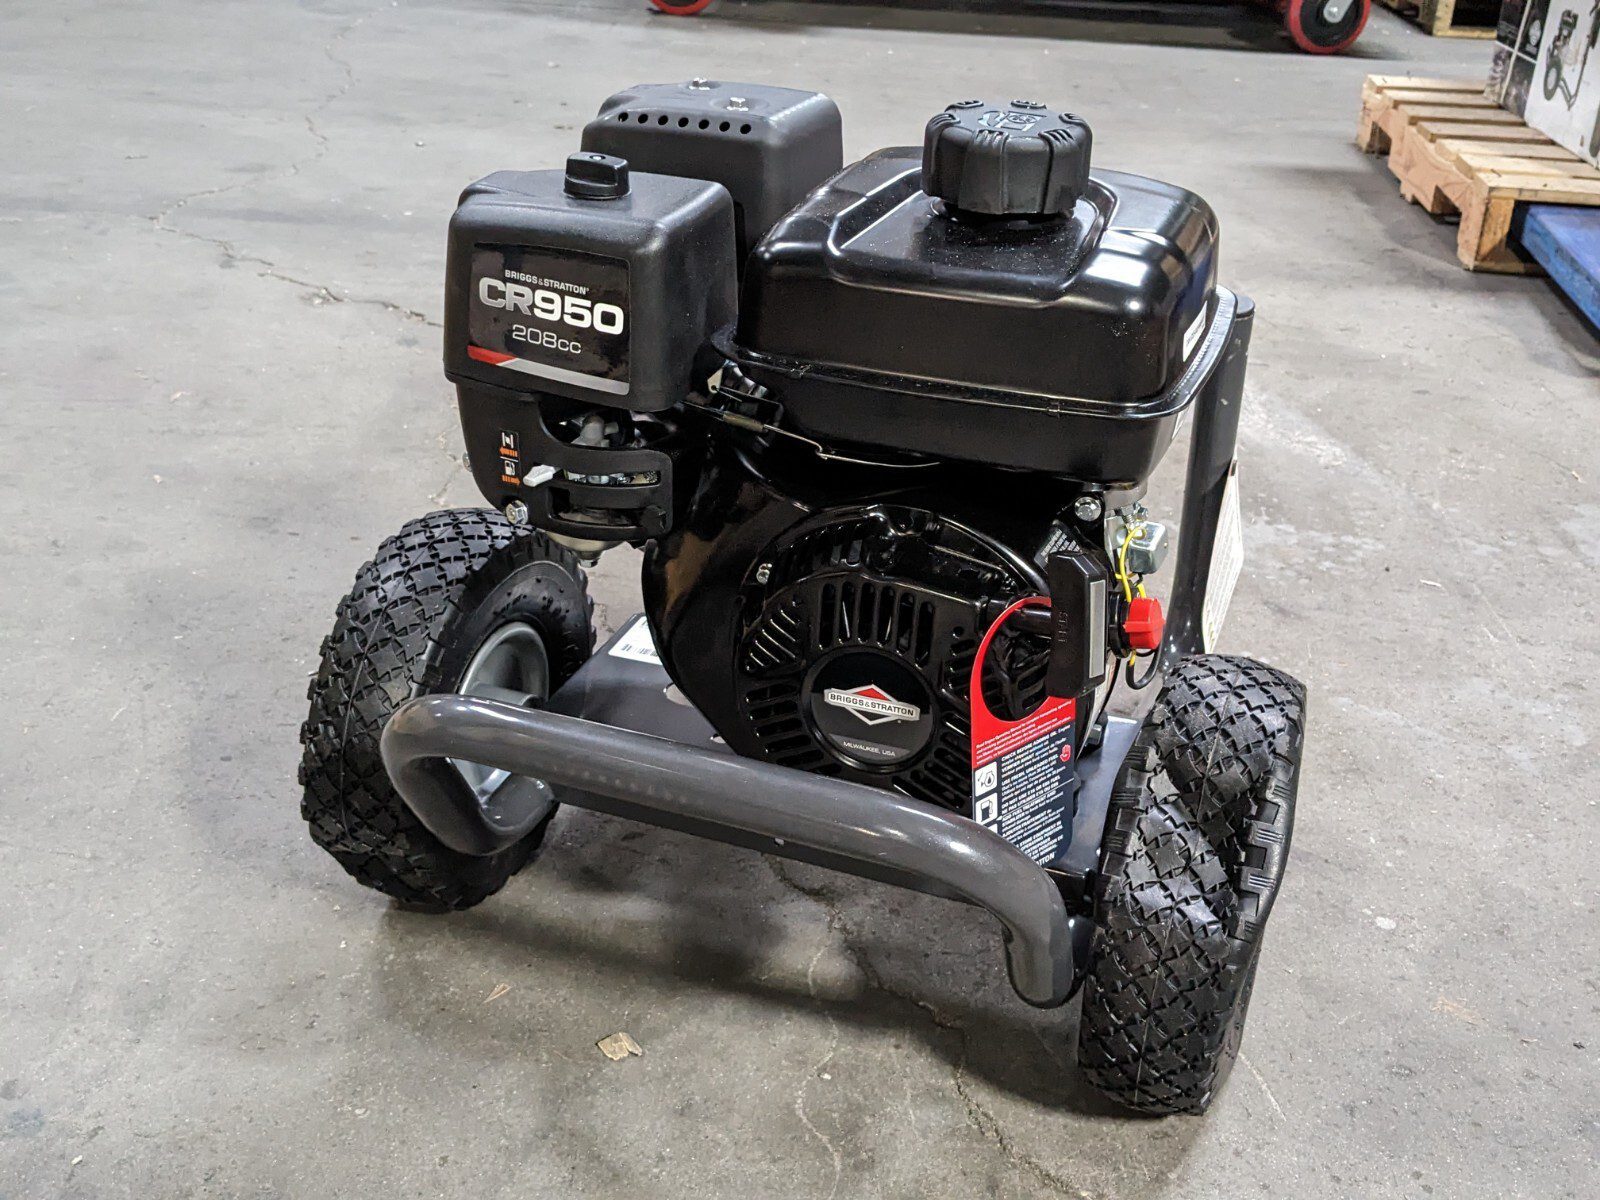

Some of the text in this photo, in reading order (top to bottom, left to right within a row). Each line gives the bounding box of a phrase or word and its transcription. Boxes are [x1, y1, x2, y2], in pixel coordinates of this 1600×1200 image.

[479, 277, 624, 335] CR950
[512, 324, 582, 354] 208cc
[882, 749, 896, 757] USA
